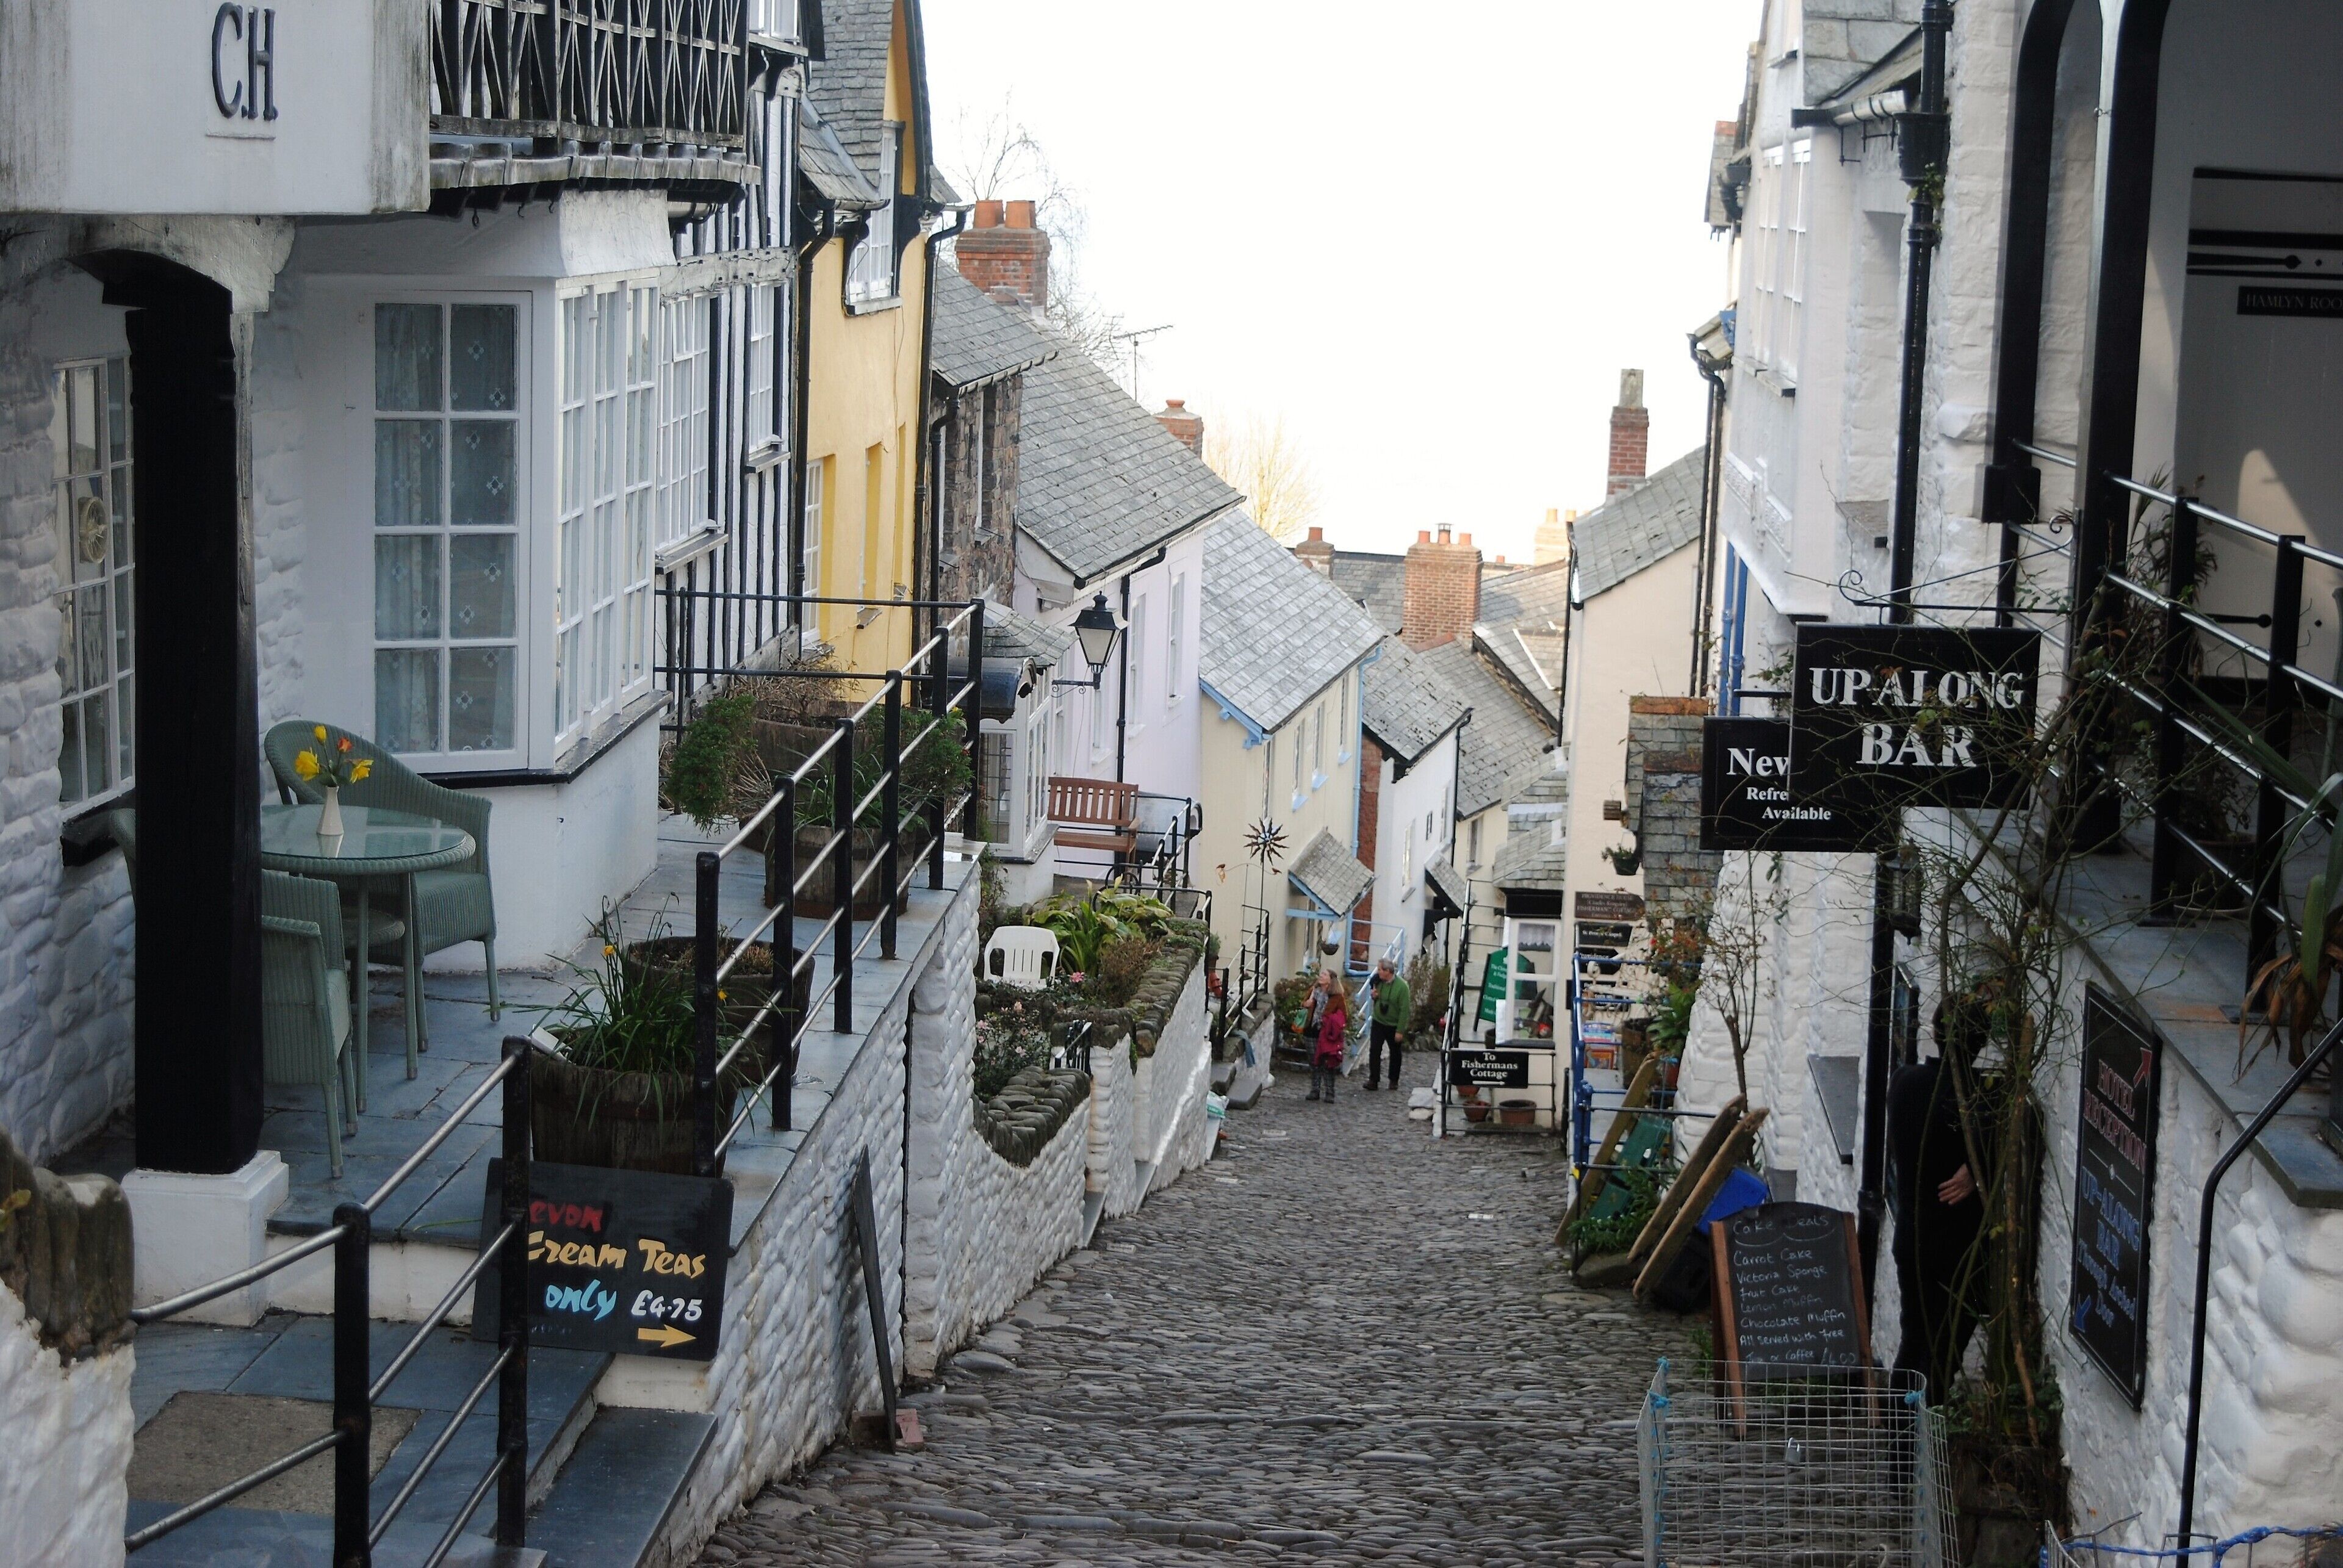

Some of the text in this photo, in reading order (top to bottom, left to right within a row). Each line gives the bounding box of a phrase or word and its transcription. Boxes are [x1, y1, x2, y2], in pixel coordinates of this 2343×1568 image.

[2246, 294, 2343, 309] HAMLYN ROO
[1855, 722, 1977, 768] BAR
[1762, 807, 1832, 820] Available
[1461, 1059, 1519, 1070] Fishermans
[1470, 1068, 1508, 1080] Cottage
[2098, 1059, 2135, 1121] HOTEL
[2083, 1087, 2147, 1175] RECEPTION
[529, 1201, 603, 1232] evon
[2081, 1166, 2140, 1251] UP-ALONG
[1733, 1215, 1829, 1235] Cake eals
[2096, 1219, 2120, 1271] BAR
[638, 1239, 705, 1279] Teas
[1733, 1248, 1813, 1266] Carrot Cake
[1737, 1264, 1827, 1284] Victoria Sponge
[546, 1279, 617, 1321] only
[1771, 1284, 1799, 1296] Cake
[1740, 1309, 1846, 1328] Chocolate Muffin
[2095, 1290, 2114, 1328] Door
[1740, 1334, 1754, 1346] All
[1791, 1331, 1816, 1343] with
[1785, 1348, 1815, 1361] Coffee
